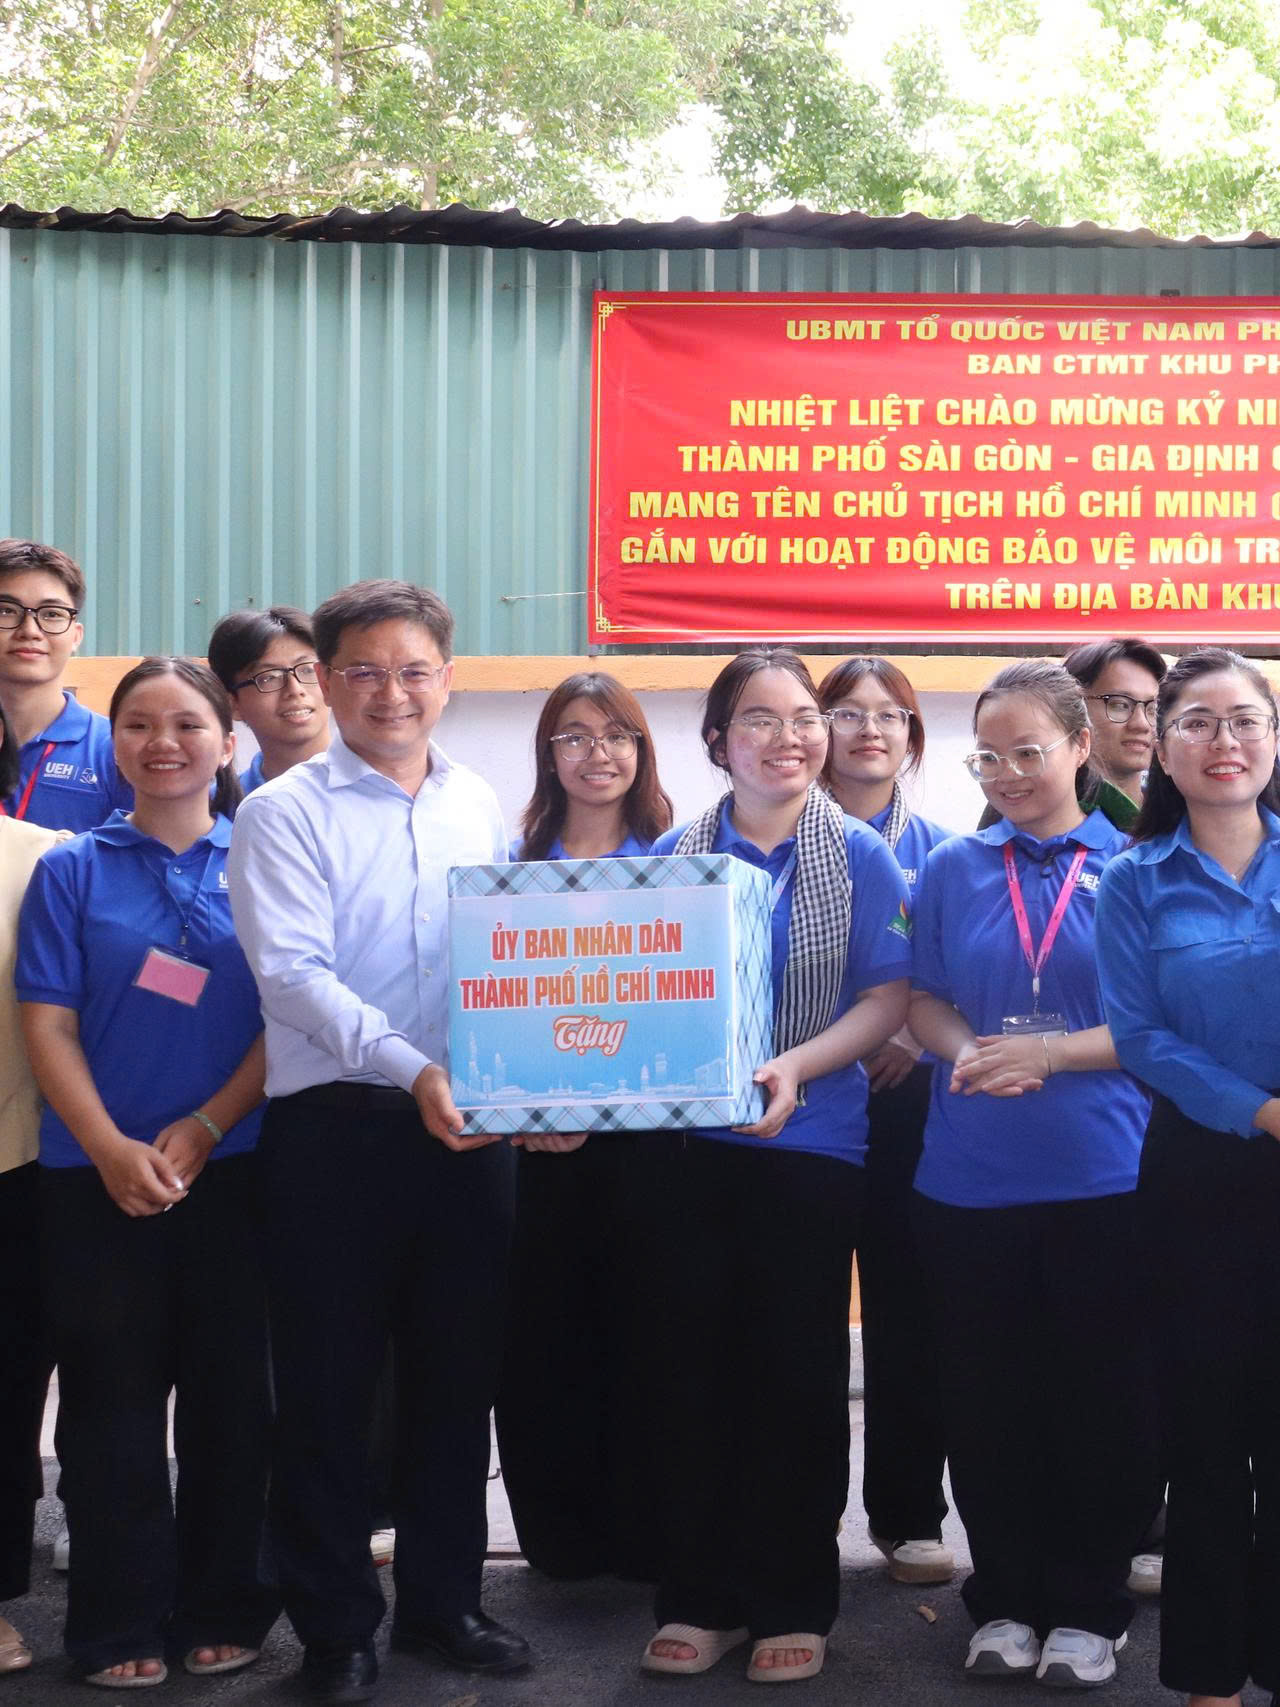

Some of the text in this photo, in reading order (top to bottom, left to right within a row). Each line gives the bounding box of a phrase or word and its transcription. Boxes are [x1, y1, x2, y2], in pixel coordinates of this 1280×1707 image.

[786, 319, 886, 341] UBMT
[895, 313, 940, 341] TỔ
[950, 315, 1045, 343] QUỐC
[1056, 318, 1131, 345] VIỆT
[1142, 321, 1225, 341] NAM
[967, 353, 1042, 375] BAN
[1053, 353, 1150, 375] CTMT
[1160, 353, 1232, 375] KHU
[729, 393, 838, 433] NHIỆT
[848, 393, 925, 432] LIỆT
[936, 392, 1037, 426] CHÀO
[1050, 393, 1164, 426] MỪNG
[1177, 389, 1226, 425] KỶ
[677, 439, 800, 473] THÀNH
[811, 435, 888, 473] PHỐ
[898, 439, 961, 472] SÀI
[974, 438, 1052, 473] GÒN
[1091, 444, 1155, 472] GIA
[1166, 444, 1259, 478] ĐỊNH
[629, 490, 740, 519] MANG
[751, 485, 821, 518] TÊN
[833, 481, 908, 518] CHỦ
[919, 490, 1004, 524] TỊCH
[1016, 481, 1066, 518] HỒ
[1079, 484, 1143, 518] CHÍ
[1155, 490, 1257, 518] MINH
[620, 527, 697, 564] GẮN
[707, 531, 768, 565] VỚI
[779, 536, 876, 570] HOẠT
[885, 531, 990, 571] ĐỘNG
[1003, 527, 1078, 565] BẢO
[1090, 531, 1136, 571] VỆ
[1148, 531, 1222, 565] MÔI
[944, 576, 1042, 609] TRÊN
[1052, 582, 1117, 615] ĐỊA
[1130, 577, 1209, 610] BÀN
[45, 761, 74, 776] UEH
[491, 918, 683, 961] ỦY BAN NHÂN DÂN
[459, 964, 715, 1010] THÀNH PHỐ HỒ CHÍ MINH
[554, 1015, 627, 1056] Tặng
